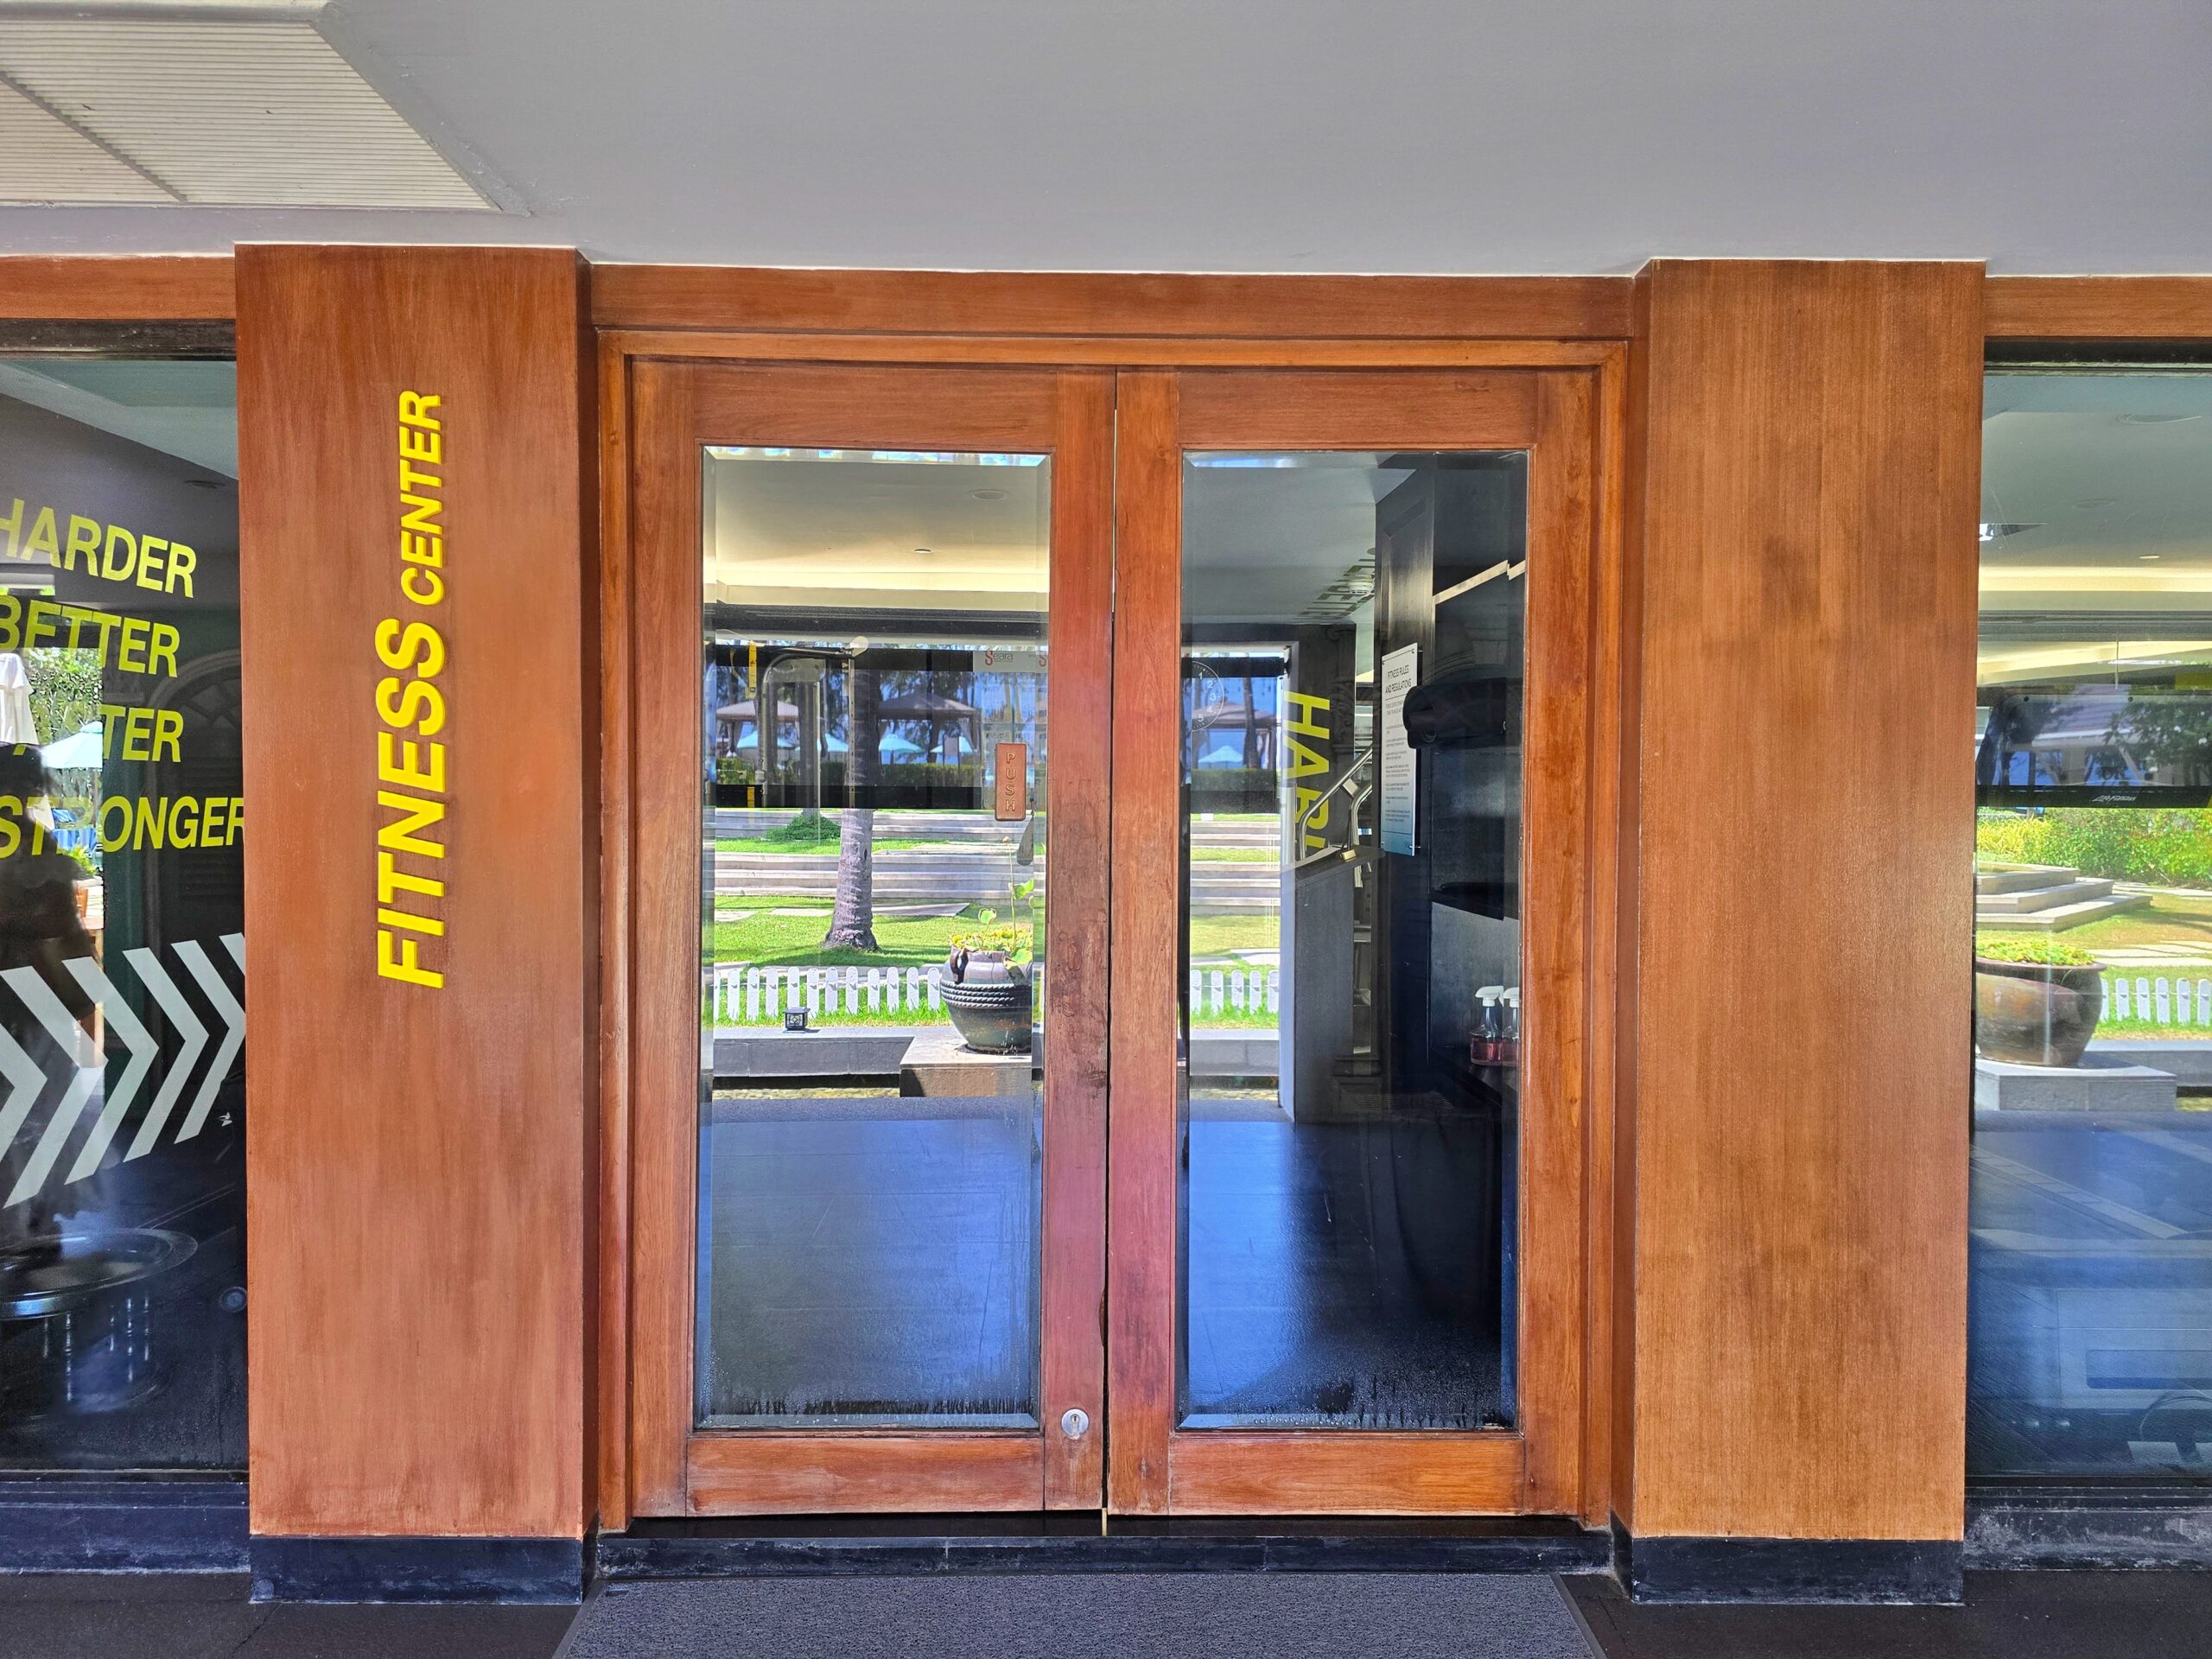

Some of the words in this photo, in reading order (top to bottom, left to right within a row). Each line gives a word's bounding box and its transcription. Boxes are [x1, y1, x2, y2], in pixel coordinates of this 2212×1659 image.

[398, 391, 444, 606] CENTER
[0, 499, 197, 598] HARDER
[0, 593, 180, 678] BETTER
[375, 619, 446, 989] FITNESS
[1006, 752, 1017, 811] PUSH
